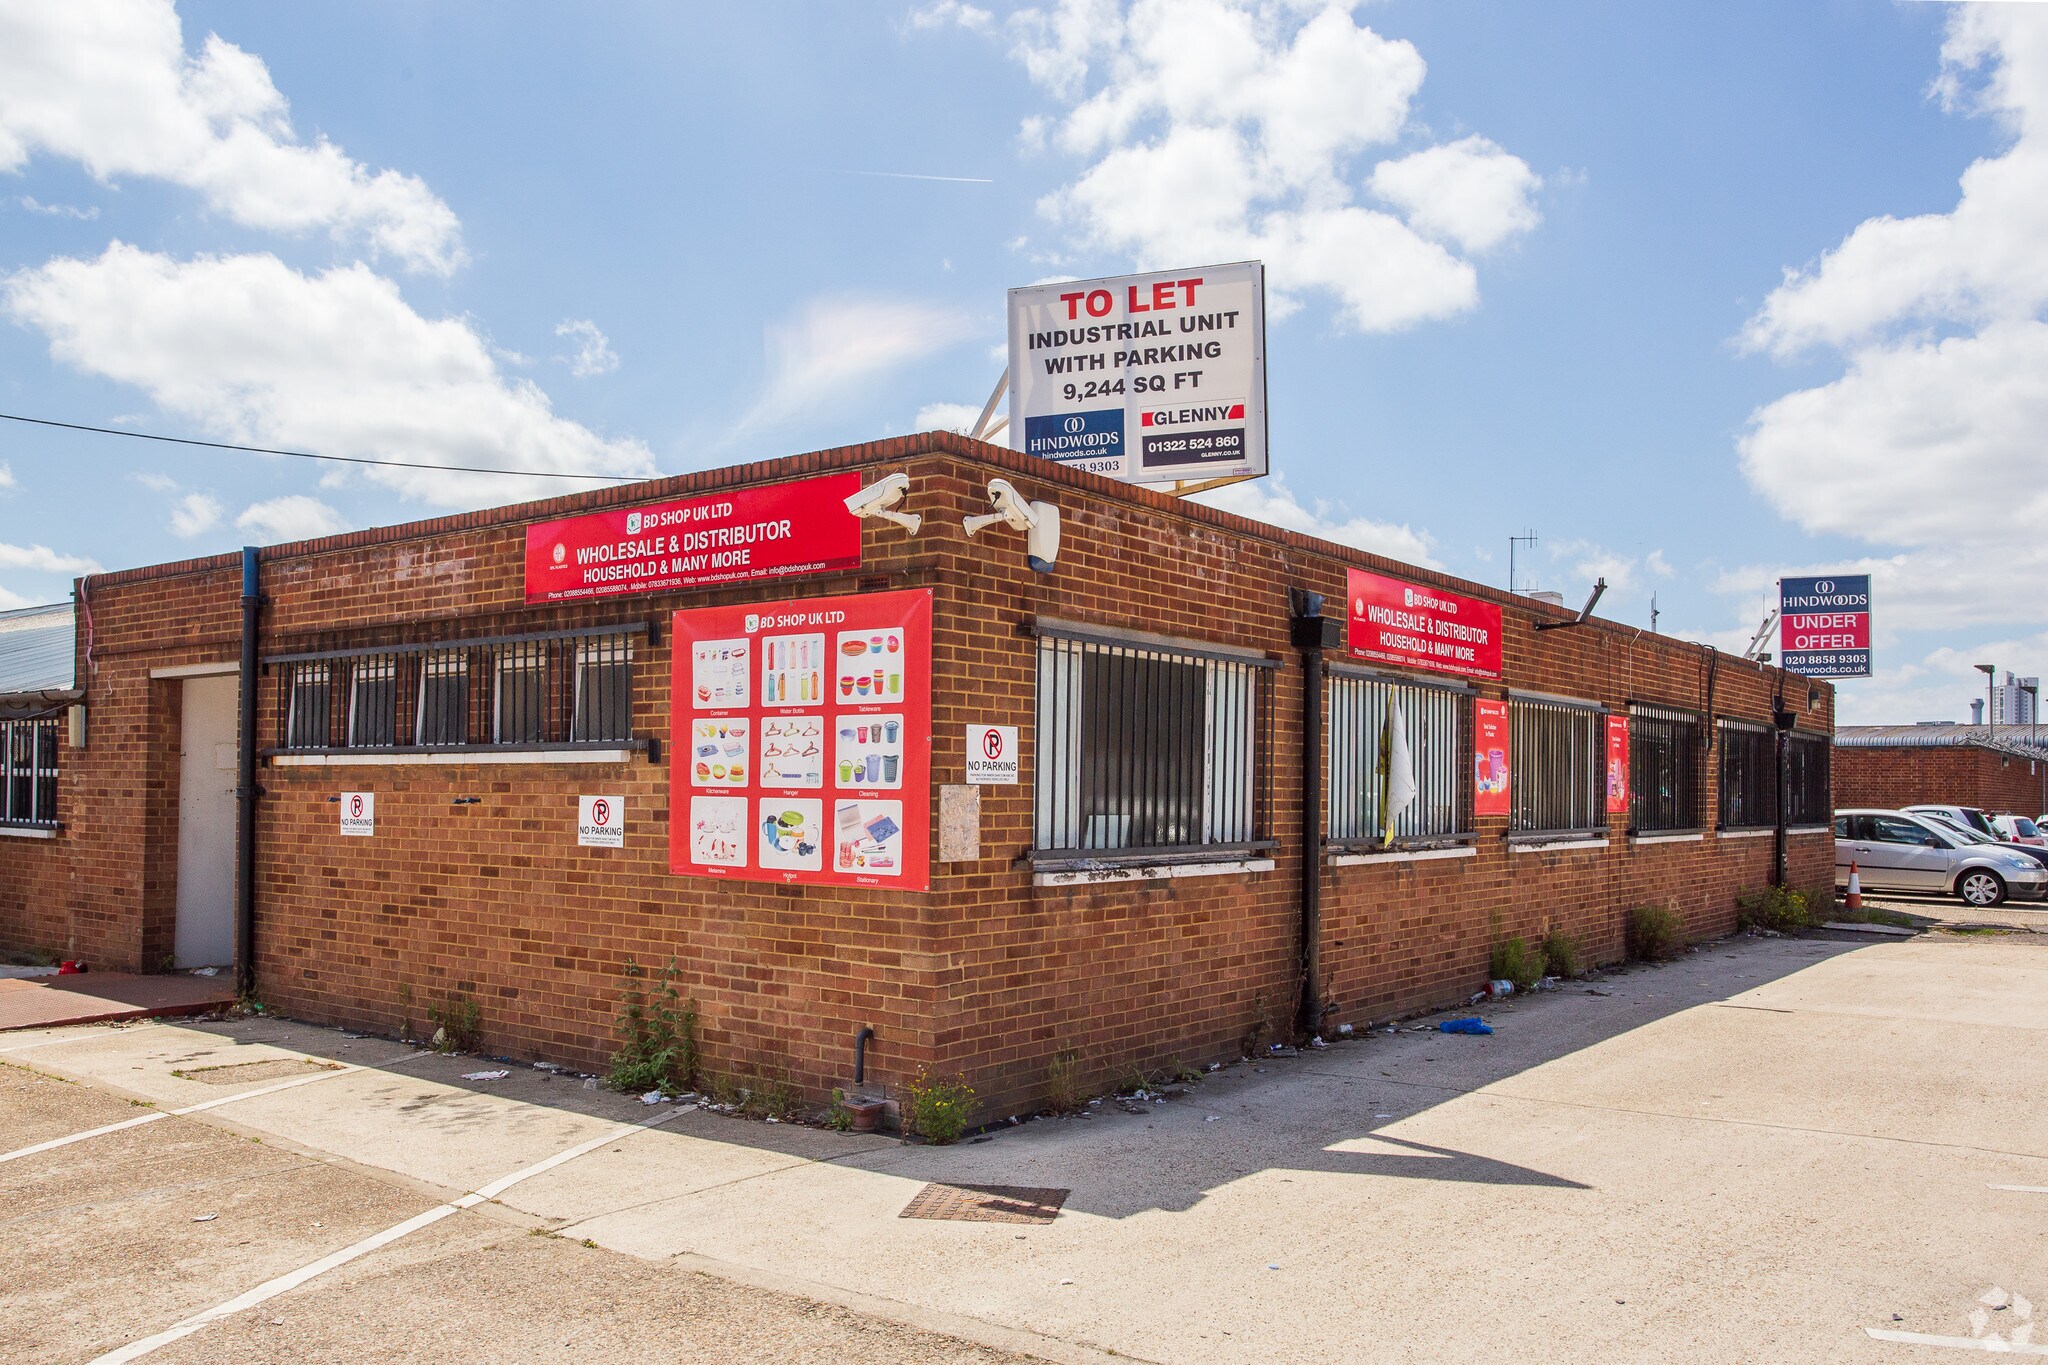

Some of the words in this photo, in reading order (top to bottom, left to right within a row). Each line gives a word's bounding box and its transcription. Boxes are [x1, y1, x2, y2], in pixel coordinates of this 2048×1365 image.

[1060, 289, 1113, 320] TO
[1128, 278, 1203, 313] LET
[1029, 319, 1172, 349] INDUSTRIAL
[1180, 311, 1239, 333] UNIT
[1045, 353, 1105, 374] WITH
[1114, 341, 1221, 367] PARKING
[1063, 379, 1126, 402] 9,244
[1133, 375, 1166, 393] SQ
[1174, 371, 1203, 389] FT
[1154, 406, 1229, 425] GLENNY
[1031, 431, 1119, 451] HINDWOODS
[1148, 440, 1187, 453] 01322
[1189, 438, 1213, 449] 524
[1215, 436, 1239, 447] 860
[1042, 447, 1107, 460] hindwoods.co.uk
[1201, 450, 1241, 458] GLENNY.CO.UK
[1090, 461, 1119, 473] 9303
[643, 514, 659, 529] BD
[660, 508, 691, 526] SHOP
[693, 505, 709, 521] UK
[711, 502, 733, 519] LTD
[576, 537, 665, 565] WHOLESALE
[668, 535, 680, 553] &
[683, 519, 791, 552] DISTRIBUTOR
[583, 561, 657, 583] HOUSEHOLD
[659, 560, 669, 575] &
[671, 554, 709, 573] MANY
[711, 549, 751, 568] MORE
[547, 591, 563, 599] Phone:
[630, 582, 648, 590] Mobile:
[683, 577, 697, 585] Web:
[751, 569, 768, 577] Email:
[768, 562, 825, 576] info@bdshopuk.com
[1413, 593, 1422, 606] BD
[1423, 596, 1439, 609] SHOP
[1439, 600, 1447, 612] UK
[1447, 602, 1457, 614] LTD
[1783, 594, 1867, 606] HINDWOODS
[760, 617, 775, 629] BD
[777, 613, 806, 627] SHOP
[808, 612, 823, 625] UK
[825, 610, 845, 624] LTD
[1368, 604, 1425, 633] WHOLESALE
[1427, 618, 1434, 634] &
[1435, 620, 1488, 645] DISTRIBUTOR
[1793, 615, 1857, 629] UNDER
[1380, 631, 1427, 653] HOUSEHOLD
[1428, 641, 1433, 654] &
[1435, 642, 1454, 658] MANY
[1455, 646, 1475, 661] MORE
[1795, 634, 1856, 648] OFFER
[1785, 656, 1806, 664] 020
[1808, 655, 1836, 664] 8858
[1839, 655, 1867, 663] 9303
[858, 705, 881, 713] Tableware
[968, 761, 980, 771] NO
[982, 761, 1017, 772] PARKING
[705, 788, 730, 796] Kitchenware
[783, 789, 799, 797] Hanger
[858, 790, 879, 798] Cleaning
[341, 818, 349, 826] NO
[350, 818, 372, 827] PARKING
[579, 826, 589, 834] NO
[591, 826, 622, 836] PARKING
[708, 867, 726, 875] Melamine
[856, 876, 879, 885] Stationary
